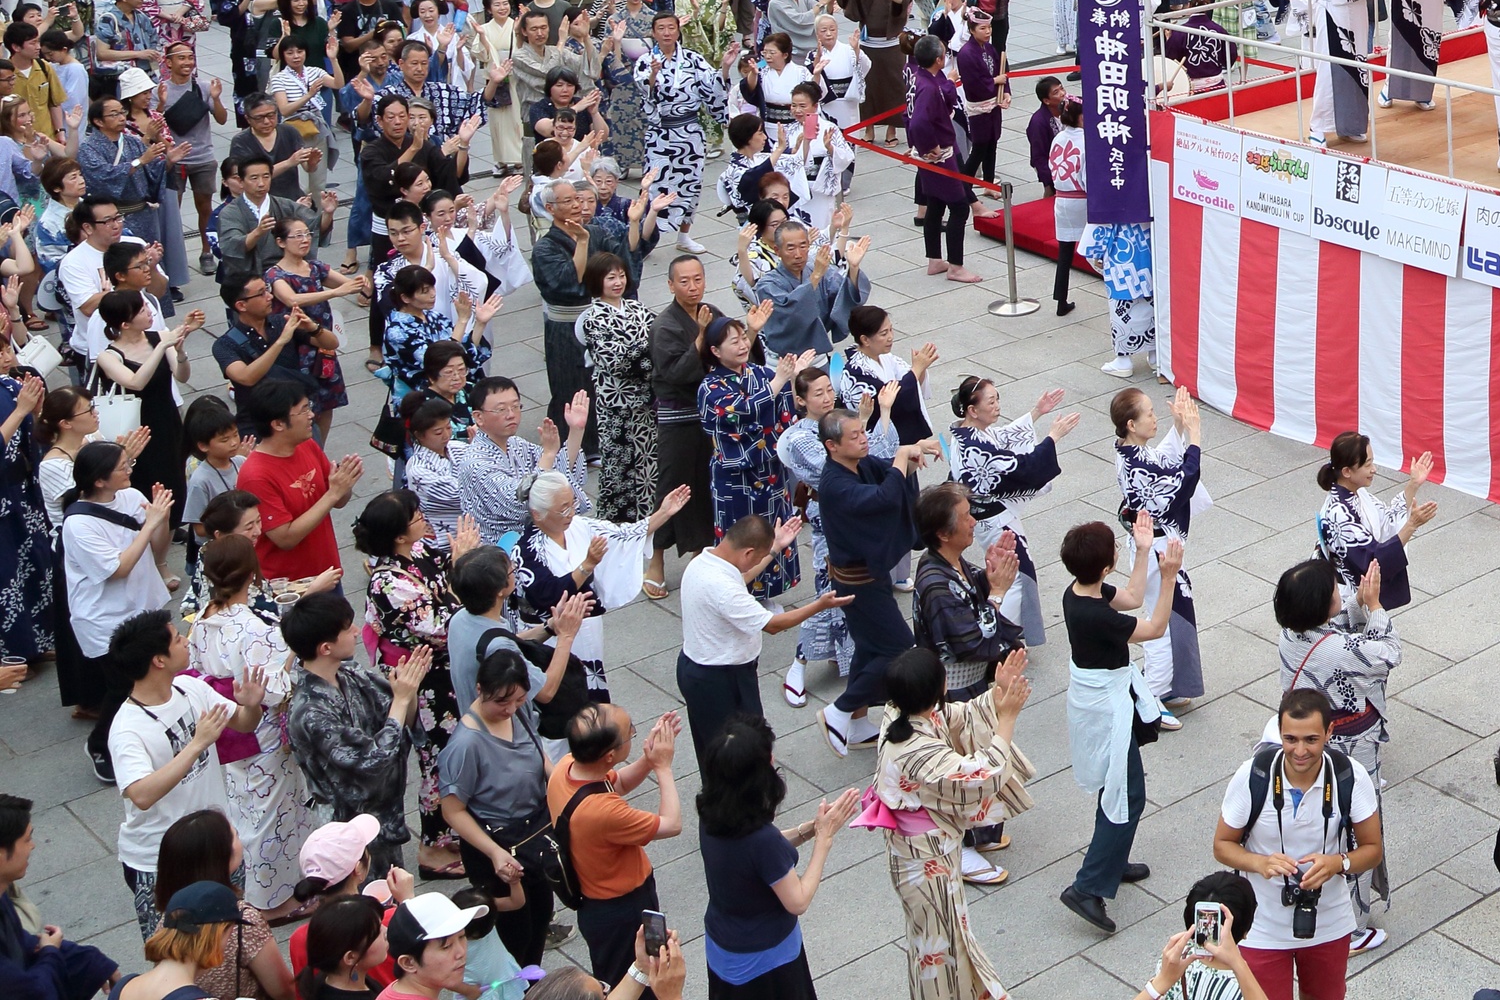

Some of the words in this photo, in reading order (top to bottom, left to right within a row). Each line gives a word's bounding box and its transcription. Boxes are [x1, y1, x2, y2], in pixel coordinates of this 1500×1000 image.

[1176, 137, 1239, 163] 絶品グルメ屋台の会
[1346, 164, 1360, 203] 名酒
[1177, 185, 1235, 212] Crocodile
[1246, 199, 1290, 220] KANDAMYOUJIN
[1292, 211, 1305, 223] CUP
[1258, 191, 1292, 209] AKIHABARA
[1389, 185, 1460, 216] 五等分の花嫁
[1313, 206, 1380, 241] Bascule
[1386, 228, 1451, 261] MAKEMIND
